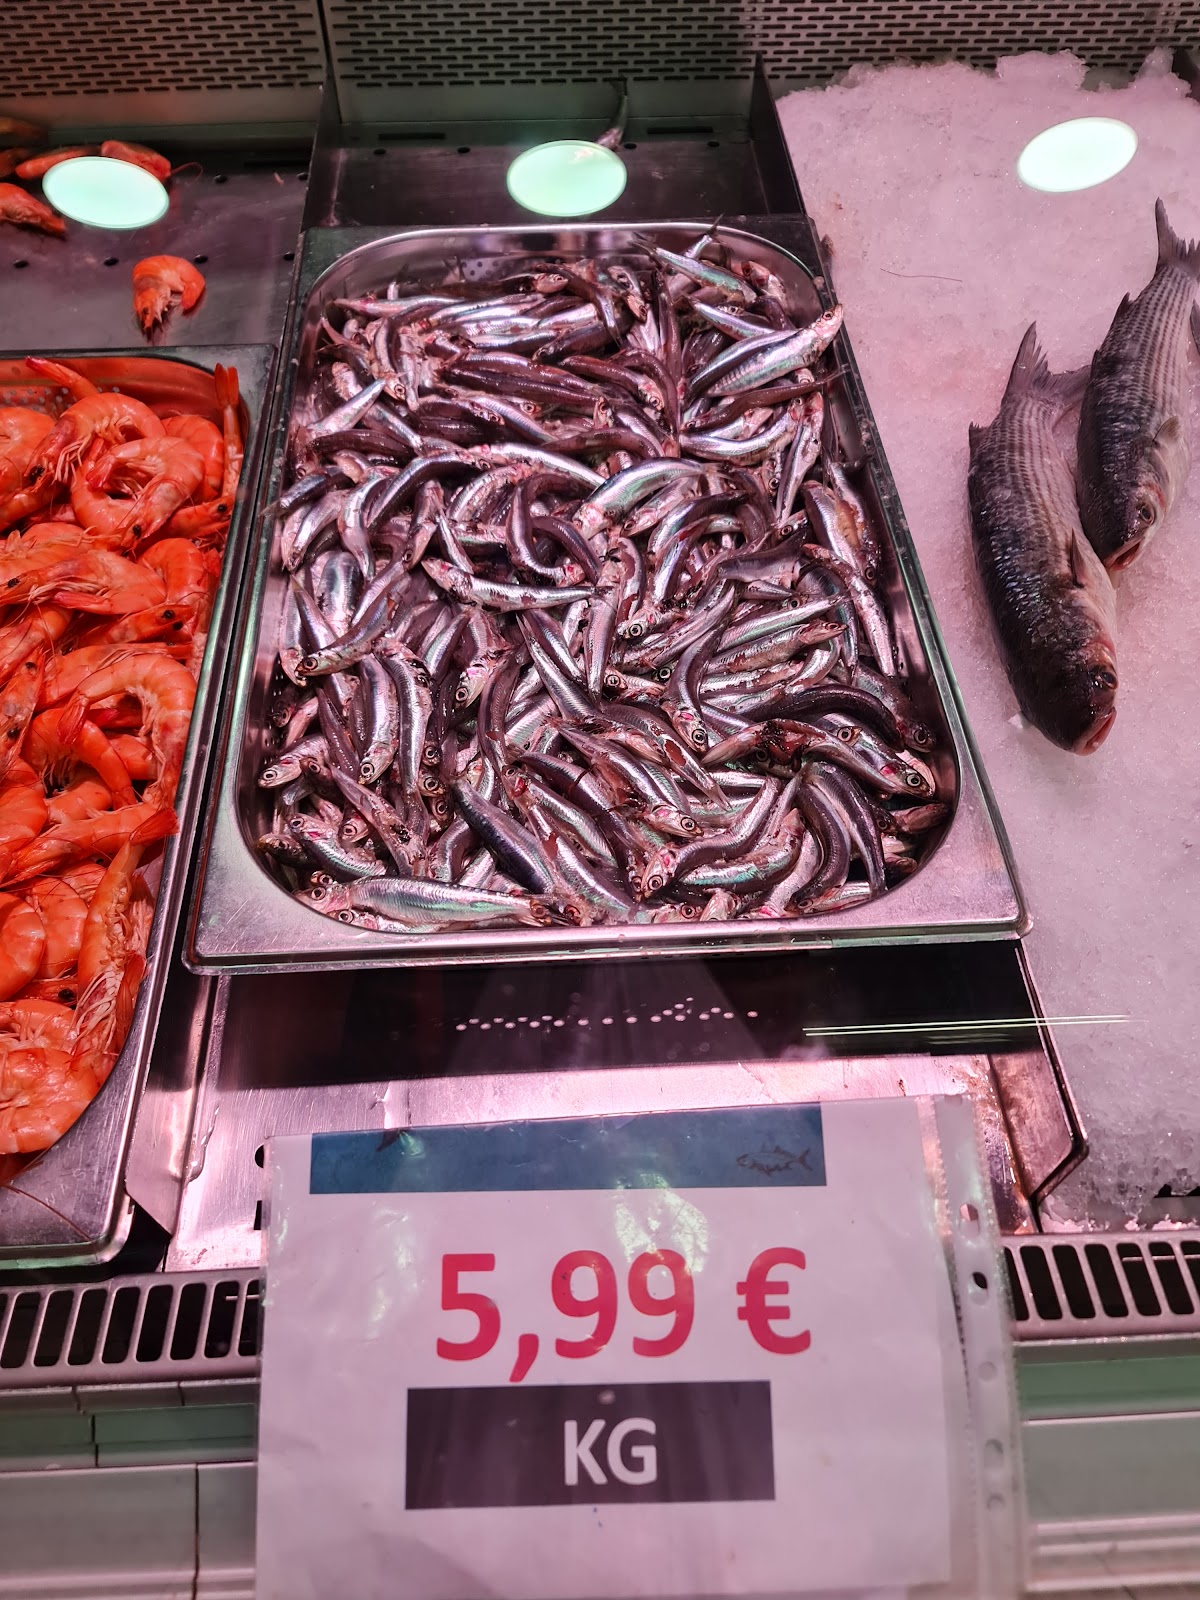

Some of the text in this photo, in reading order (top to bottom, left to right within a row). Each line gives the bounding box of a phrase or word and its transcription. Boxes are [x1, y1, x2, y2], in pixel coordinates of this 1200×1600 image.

[436, 1247, 812, 1384] 5,99 €
[563, 1417, 657, 1486] KG
